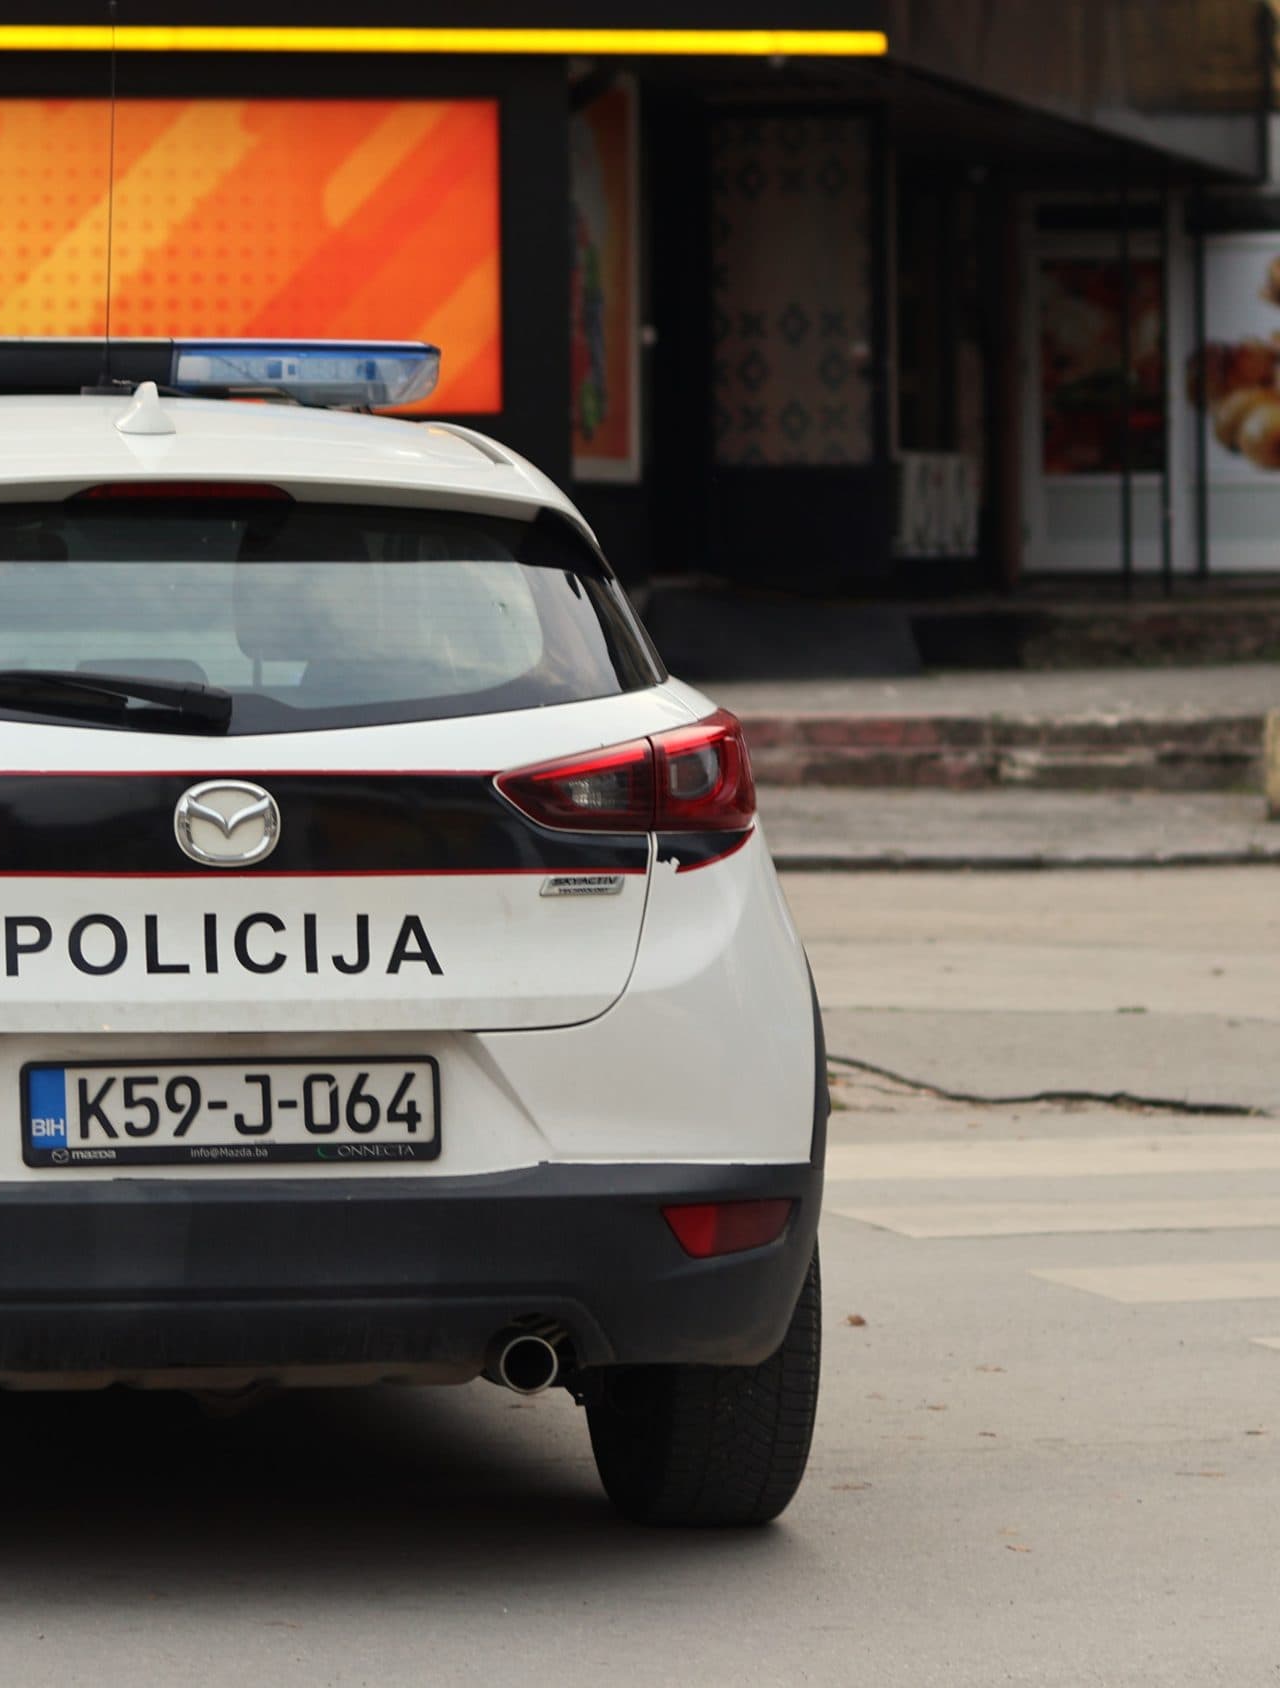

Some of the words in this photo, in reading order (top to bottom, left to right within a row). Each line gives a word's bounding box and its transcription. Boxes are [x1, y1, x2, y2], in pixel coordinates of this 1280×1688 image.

[4, 912, 444, 976] POLICIJA
[31, 1118, 65, 1137] BIH
[77, 1072, 422, 1140] K59-J-064
